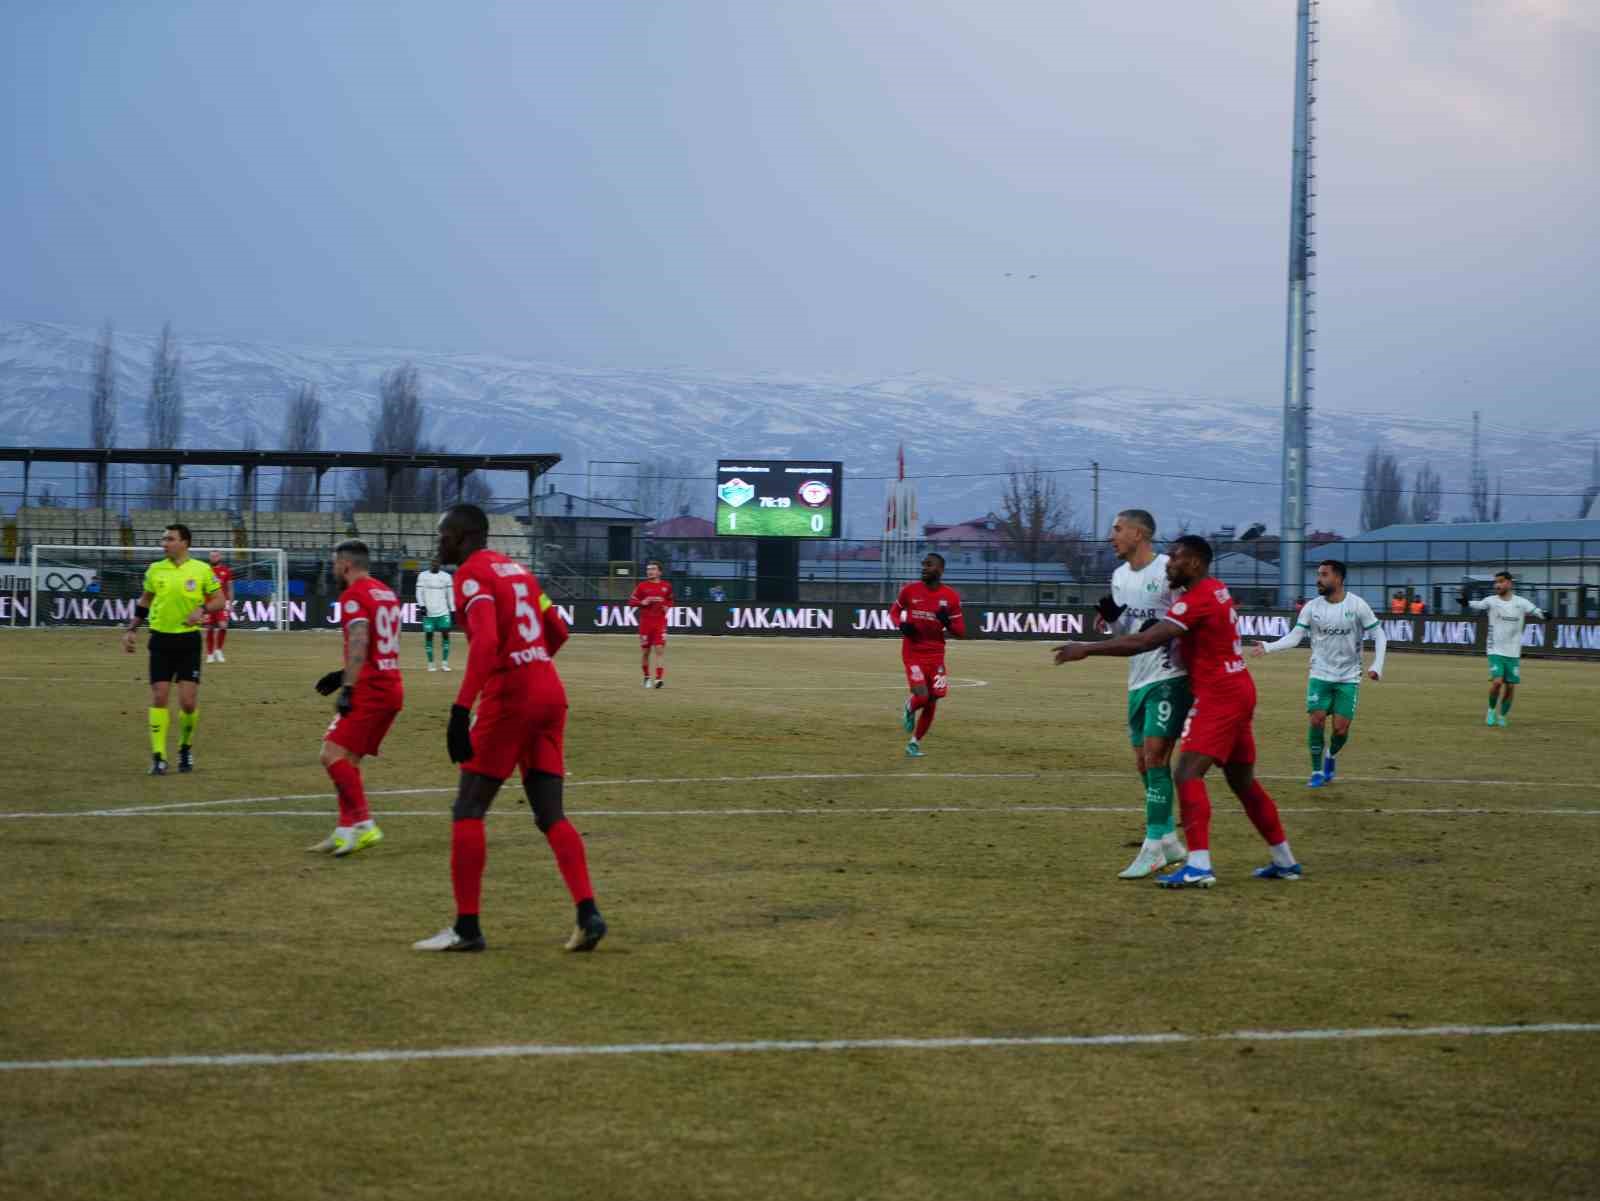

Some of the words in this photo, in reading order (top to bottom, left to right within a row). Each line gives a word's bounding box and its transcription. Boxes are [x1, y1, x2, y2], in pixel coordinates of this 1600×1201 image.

[728, 512, 737, 530] 1
[811, 513, 824, 532] 0
[50, 597, 136, 620] JAKAM
[511, 582, 541, 642] 5
[726, 607, 833, 629] JAKAMEN
[980, 611, 1083, 634] JAKAMEN
[1237, 615, 1291, 638] AKAMEN
[1158, 700, 1172, 722] 9
